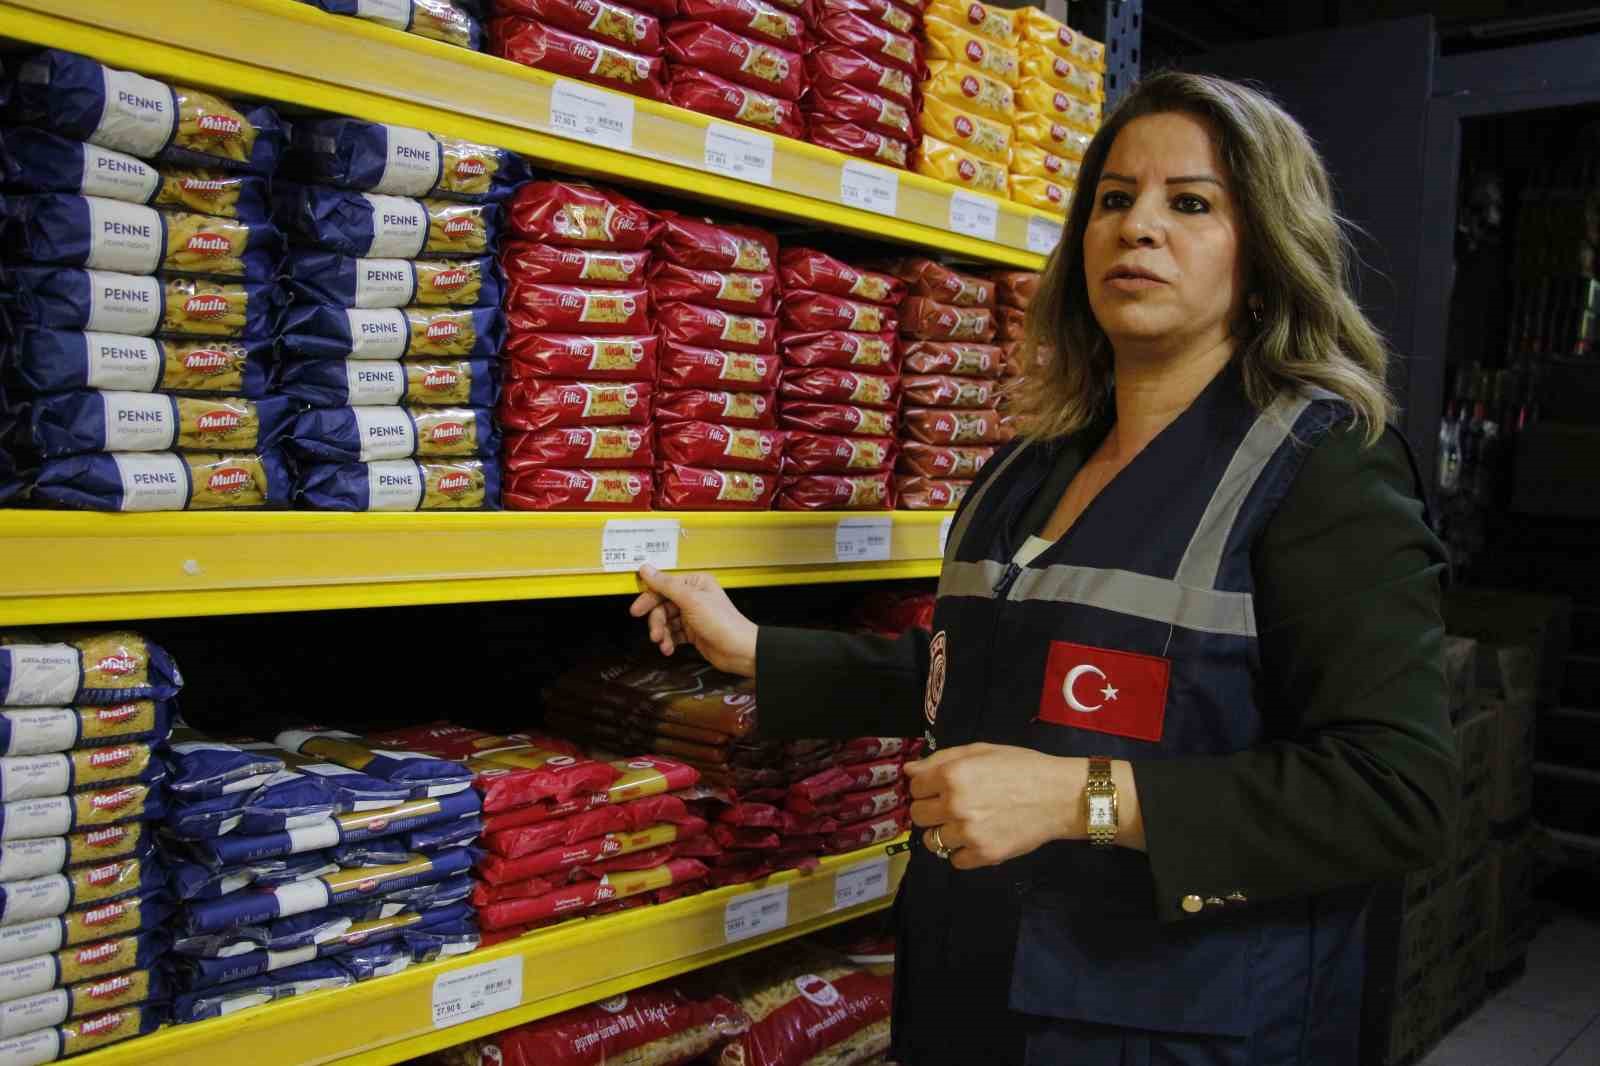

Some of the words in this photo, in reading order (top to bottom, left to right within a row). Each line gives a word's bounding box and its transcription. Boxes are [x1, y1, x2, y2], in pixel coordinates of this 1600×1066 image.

[119, 90, 162, 112] PENNE
[396, 146, 432, 161] PENNE
[97, 156, 146, 176] PENNE
[456, 162, 487, 176] Mutlu
[384, 214, 418, 226] PENNE
[444, 220, 474, 232] Mutlu
[104, 220, 150, 238] PENNE
[188, 238, 230, 250] Mutlu
[367, 270, 404, 281] PENNE
[433, 272, 466, 287] Mutlu
[104, 288, 150, 303] PENNE
[186, 298, 226, 312] Mutlu
[362, 322, 398, 334] PENNE
[427, 325, 459, 338] Mutlu
[101, 346, 148, 360] PENNE
[186, 355, 226, 370] Mutlu
[358, 371, 395, 382] PENNE
[424, 374, 456, 386] Mutlu
[118, 410, 162, 422] PENNE
[199, 414, 240, 428] Mutlu
[370, 426, 405, 438] PENNE
[432, 426, 464, 438] Mutlu
[134, 472, 176, 485] PENNE
[210, 473, 249, 488] Mutlu
[380, 475, 413, 486] PENNE
[440, 476, 470, 488] Mutlu
[93, 750, 130, 764] Mutlu
[88, 827, 124, 844] Mutlu
[85, 904, 124, 924] Mutlu
[80, 944, 118, 961] Mutlu
[92, 976, 130, 996] Mutlu
[82, 1014, 120, 1033] Mutlu
